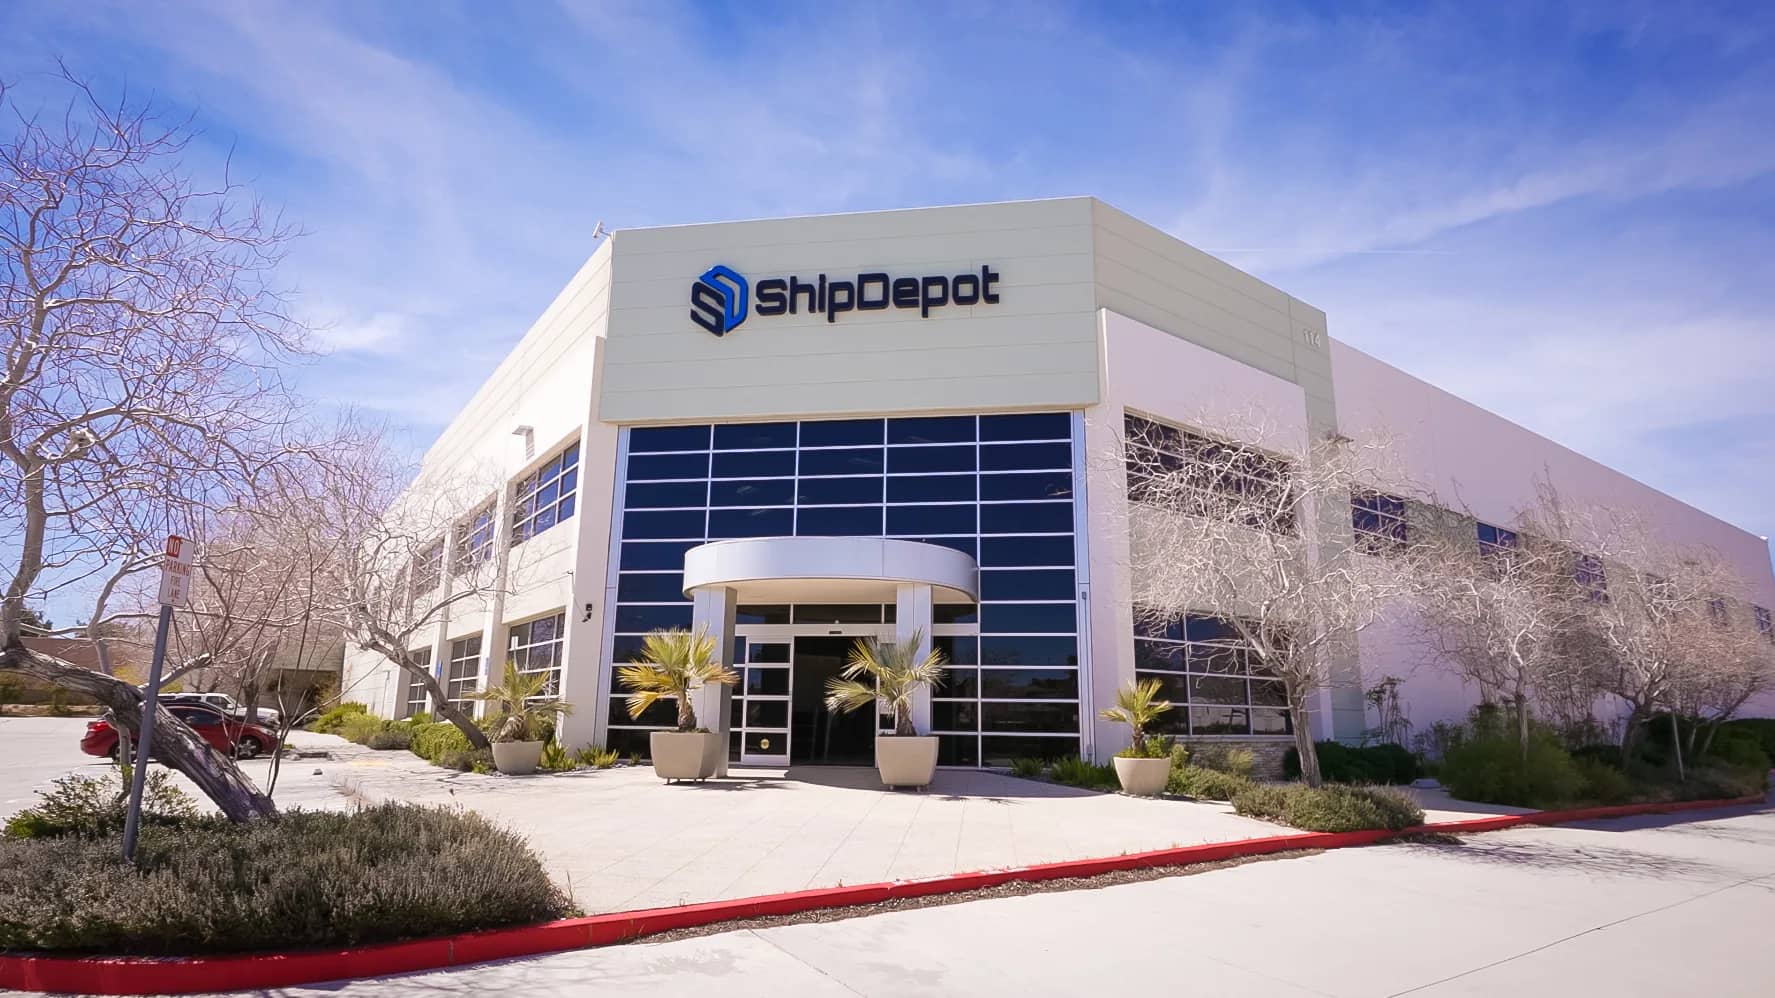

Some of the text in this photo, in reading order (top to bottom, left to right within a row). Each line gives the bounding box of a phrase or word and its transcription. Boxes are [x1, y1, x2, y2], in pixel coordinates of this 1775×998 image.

[755, 264, 1000, 323] ShipDepot
[169, 537, 180, 554] NO
[165, 559, 191, 577] PARKING
